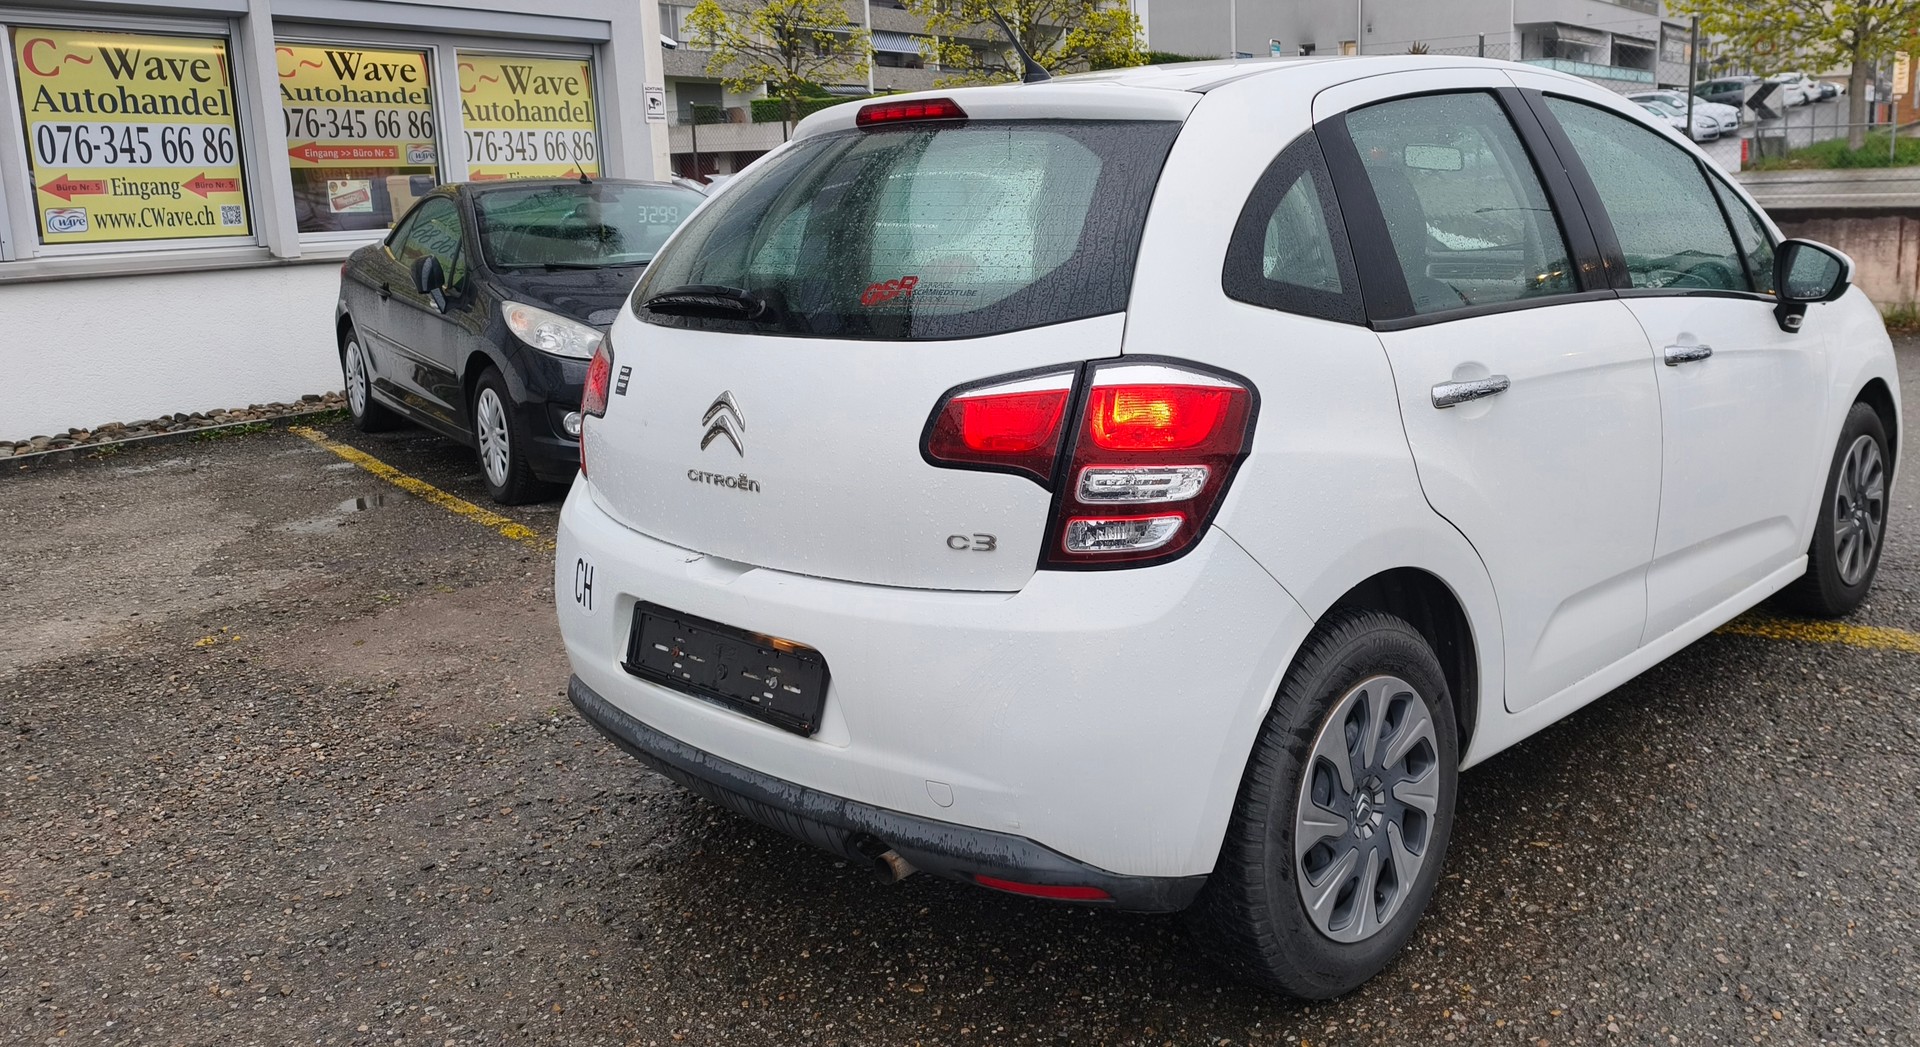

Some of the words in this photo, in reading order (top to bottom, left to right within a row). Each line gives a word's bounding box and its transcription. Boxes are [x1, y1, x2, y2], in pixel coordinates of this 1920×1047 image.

[32, 84, 231, 116] Autohandel
[280, 83, 432, 105] Autohandel
[461, 99, 593, 123] Autohandel
[374, 110, 400, 139] 66
[408, 111, 433, 139] 86
[37, 124, 152, 164] 076-345
[161, 126, 194, 164] 66
[202, 127, 234, 164] 86
[305, 149, 338, 159] Eingang
[353, 149, 373, 157] Büro
[375, 149, 388, 157] Nr.
[389, 149, 394, 157] 5
[544, 131, 567, 161] 66
[572, 131, 594, 161] 86
[56, 183, 78, 191] Büro
[79, 183, 93, 191] Nr.
[95, 183, 101, 191] 5
[111, 177, 181, 199] Eingang
[195, 181, 213, 189] Büro
[214, 181, 227, 189] Nr.
[228, 181, 234, 189] 5
[94, 206, 215, 229] www.CWave.ch
[946, 533, 997, 552] C3
[575, 557, 594, 611] CH
